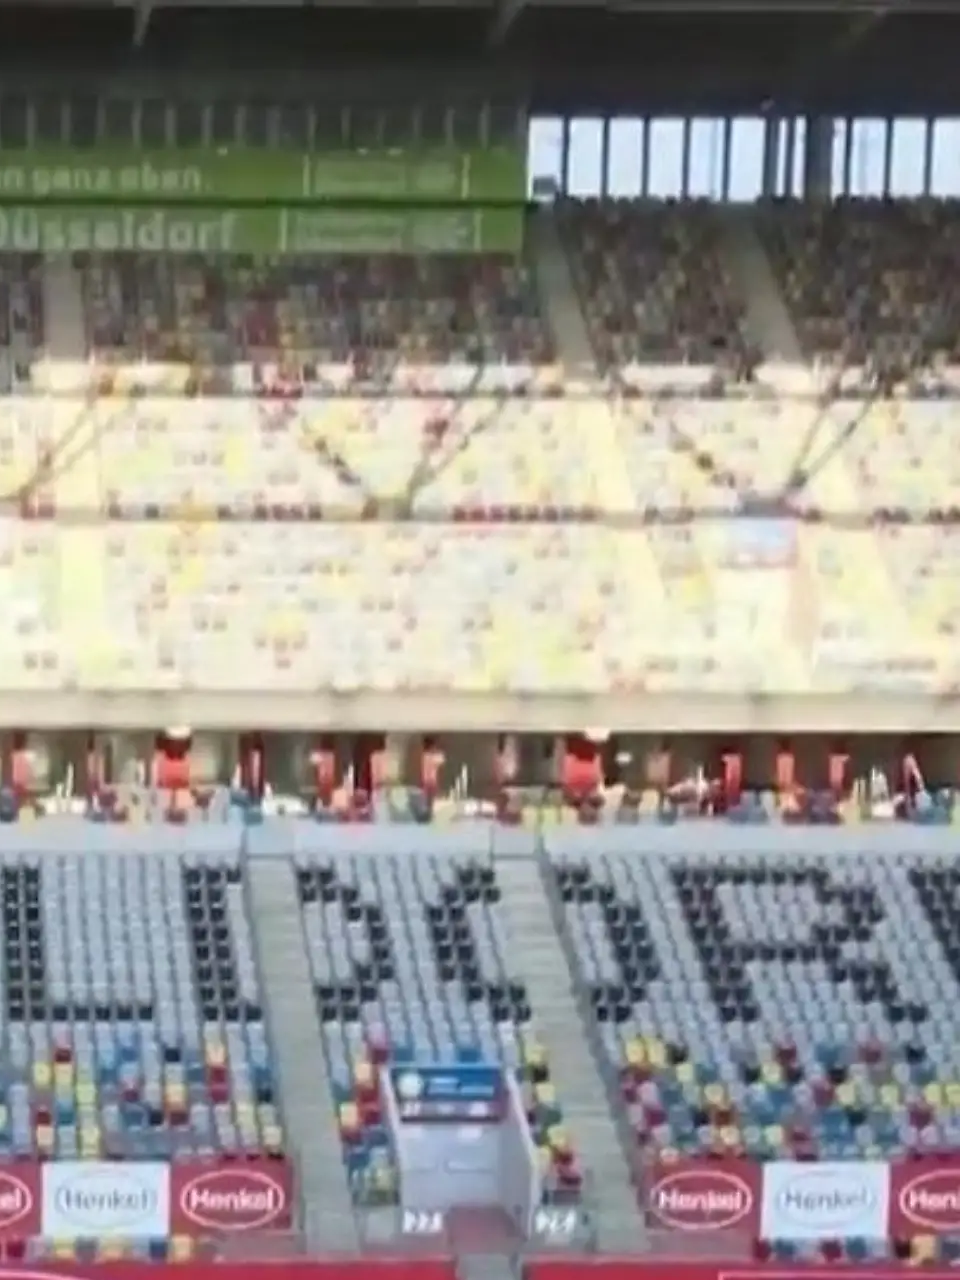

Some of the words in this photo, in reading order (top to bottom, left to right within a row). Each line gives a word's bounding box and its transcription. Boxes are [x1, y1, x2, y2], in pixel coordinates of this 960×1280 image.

[64, 1186, 150, 1212] Henkel
[190, 1186, 275, 1212] Henkel
[657, 1187, 742, 1213] Henkel
